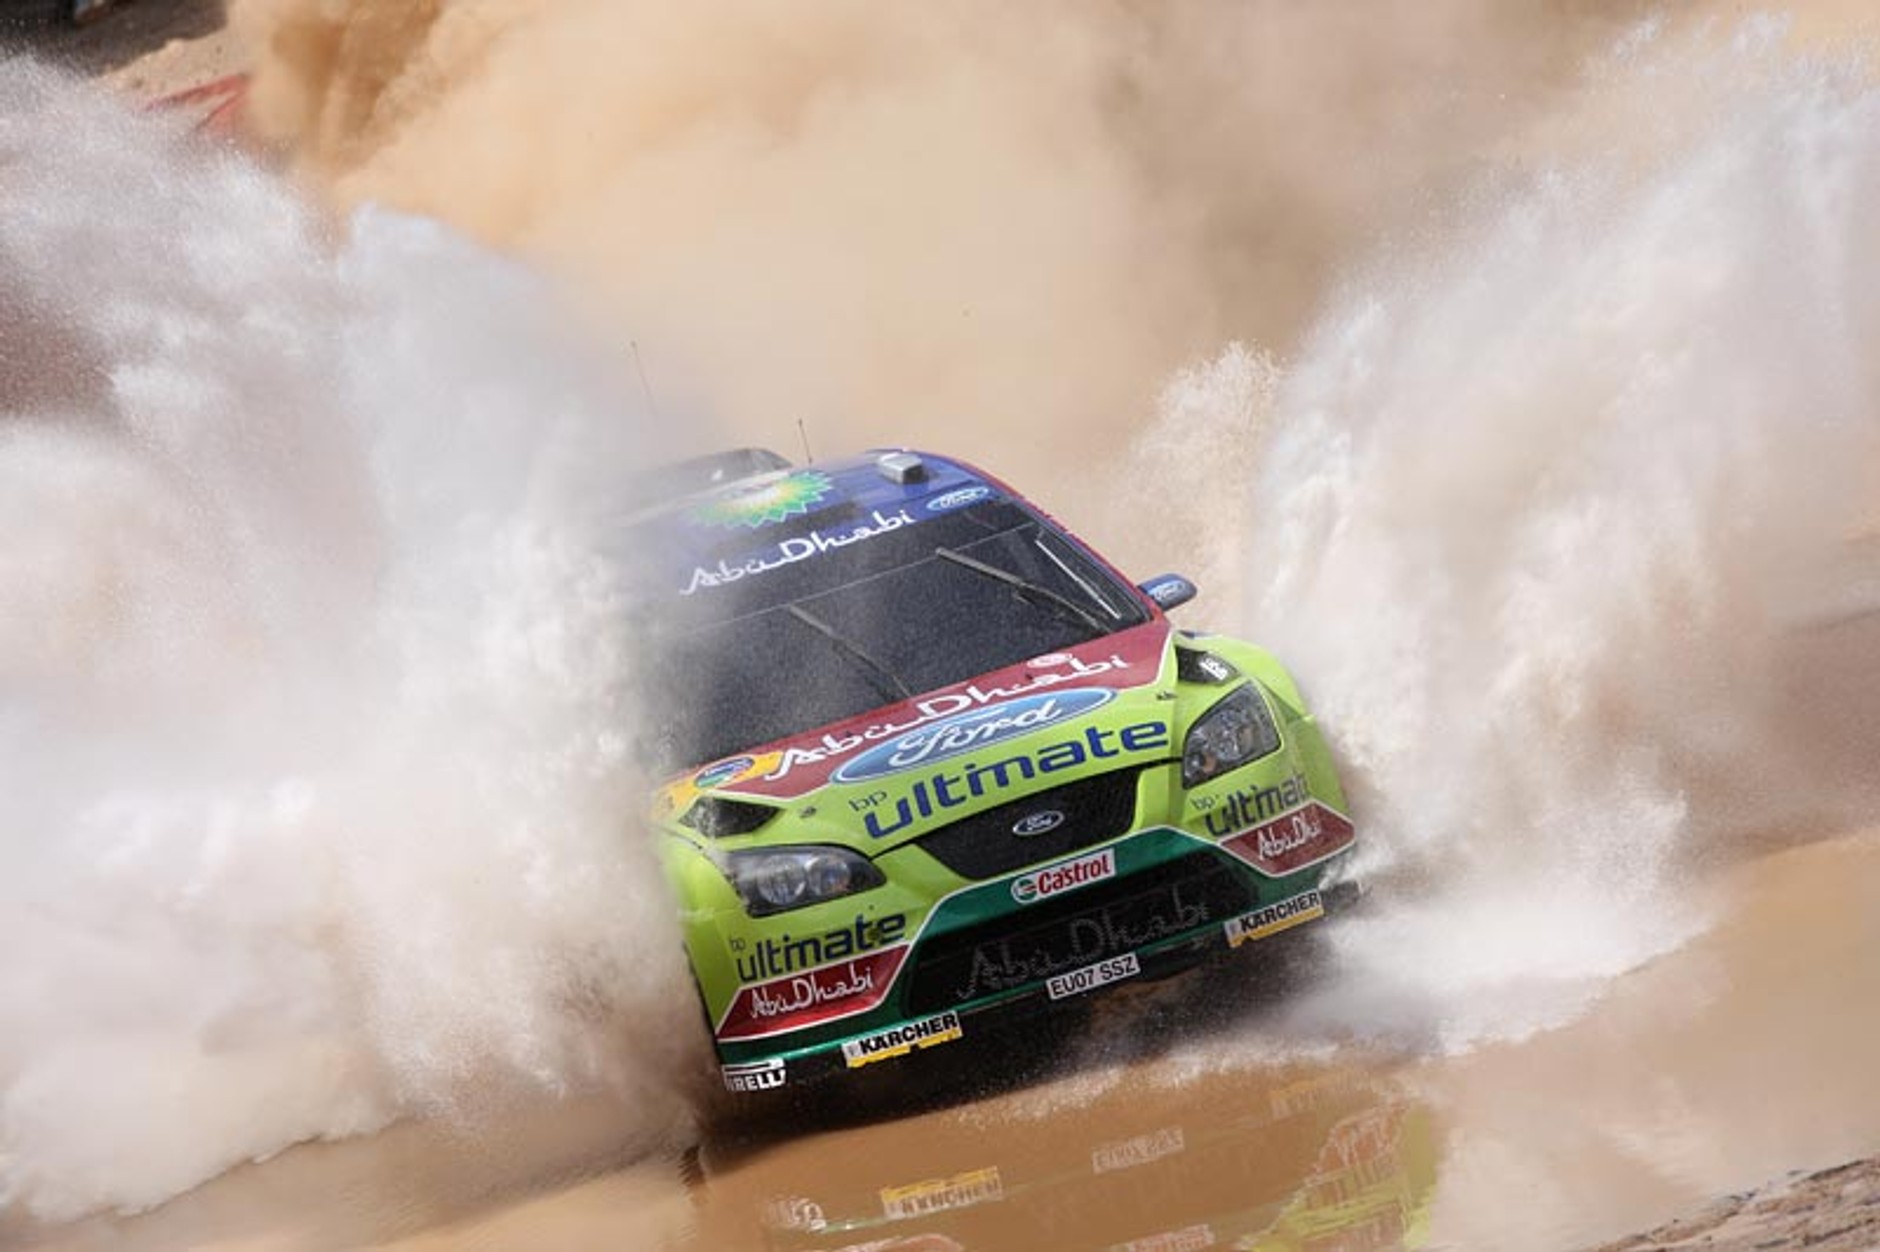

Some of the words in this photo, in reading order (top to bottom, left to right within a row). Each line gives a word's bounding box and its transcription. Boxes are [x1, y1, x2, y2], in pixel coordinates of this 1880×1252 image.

[887, 699, 1063, 766] Ford
[848, 790, 887, 811] bp
[864, 721, 1168, 839] ultimate
[1038, 854, 1110, 894] Castrol
[736, 913, 906, 982] ultimate
[1051, 968, 1095, 996] EU07
[1100, 956, 1136, 981] SSZ
